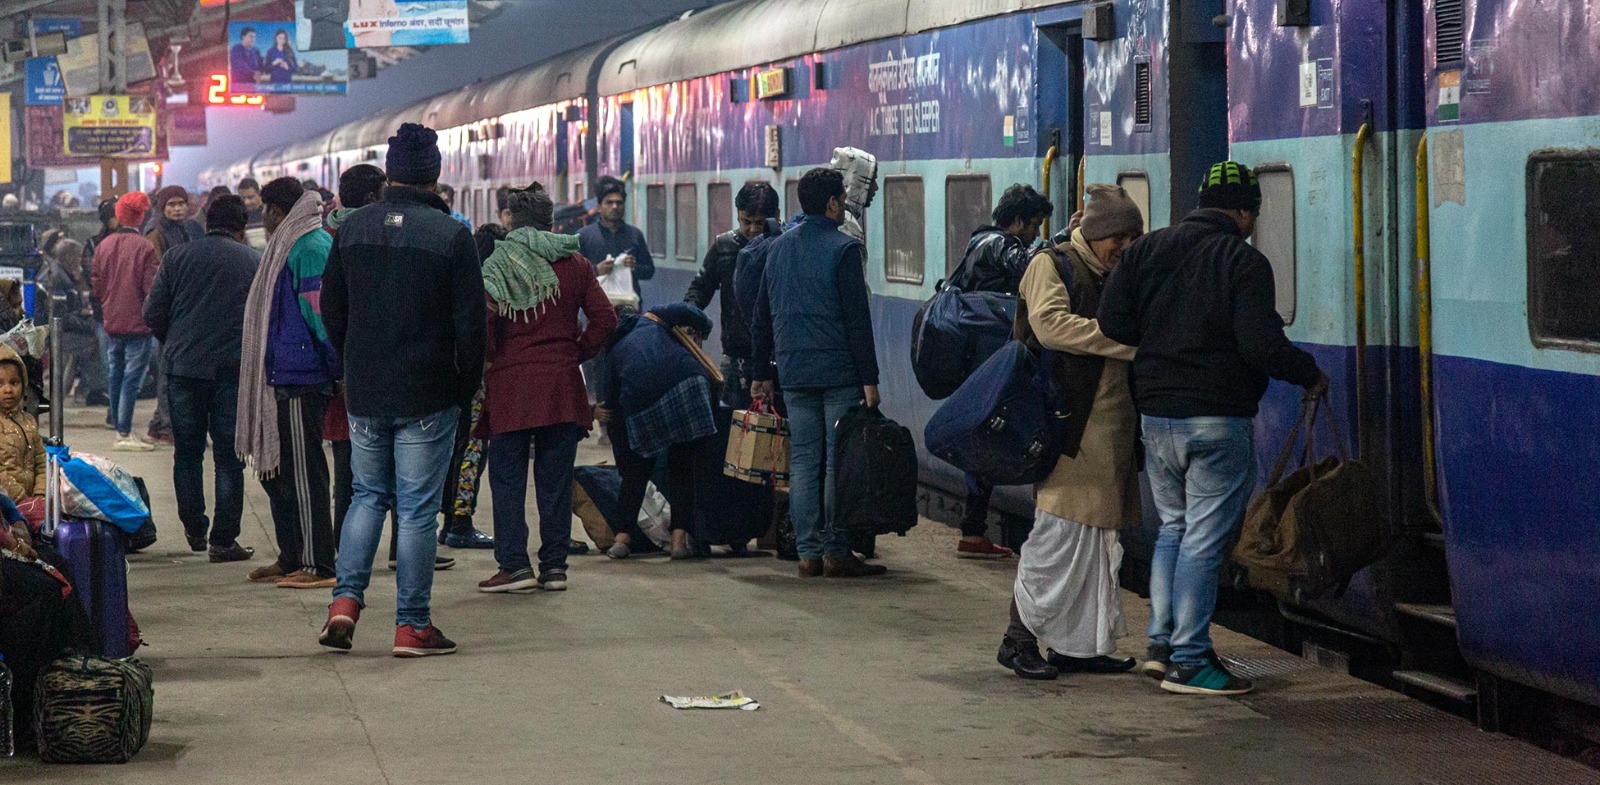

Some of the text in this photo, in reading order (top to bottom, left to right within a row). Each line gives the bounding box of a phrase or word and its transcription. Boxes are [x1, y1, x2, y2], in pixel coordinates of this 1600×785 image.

[352, 20, 378, 29] LUX
[379, 18, 407, 28] Inferno
[880, 104, 898, 135] THREE
[899, 102, 914, 134] TIER
[914, 99, 940, 133] SLEEPER
